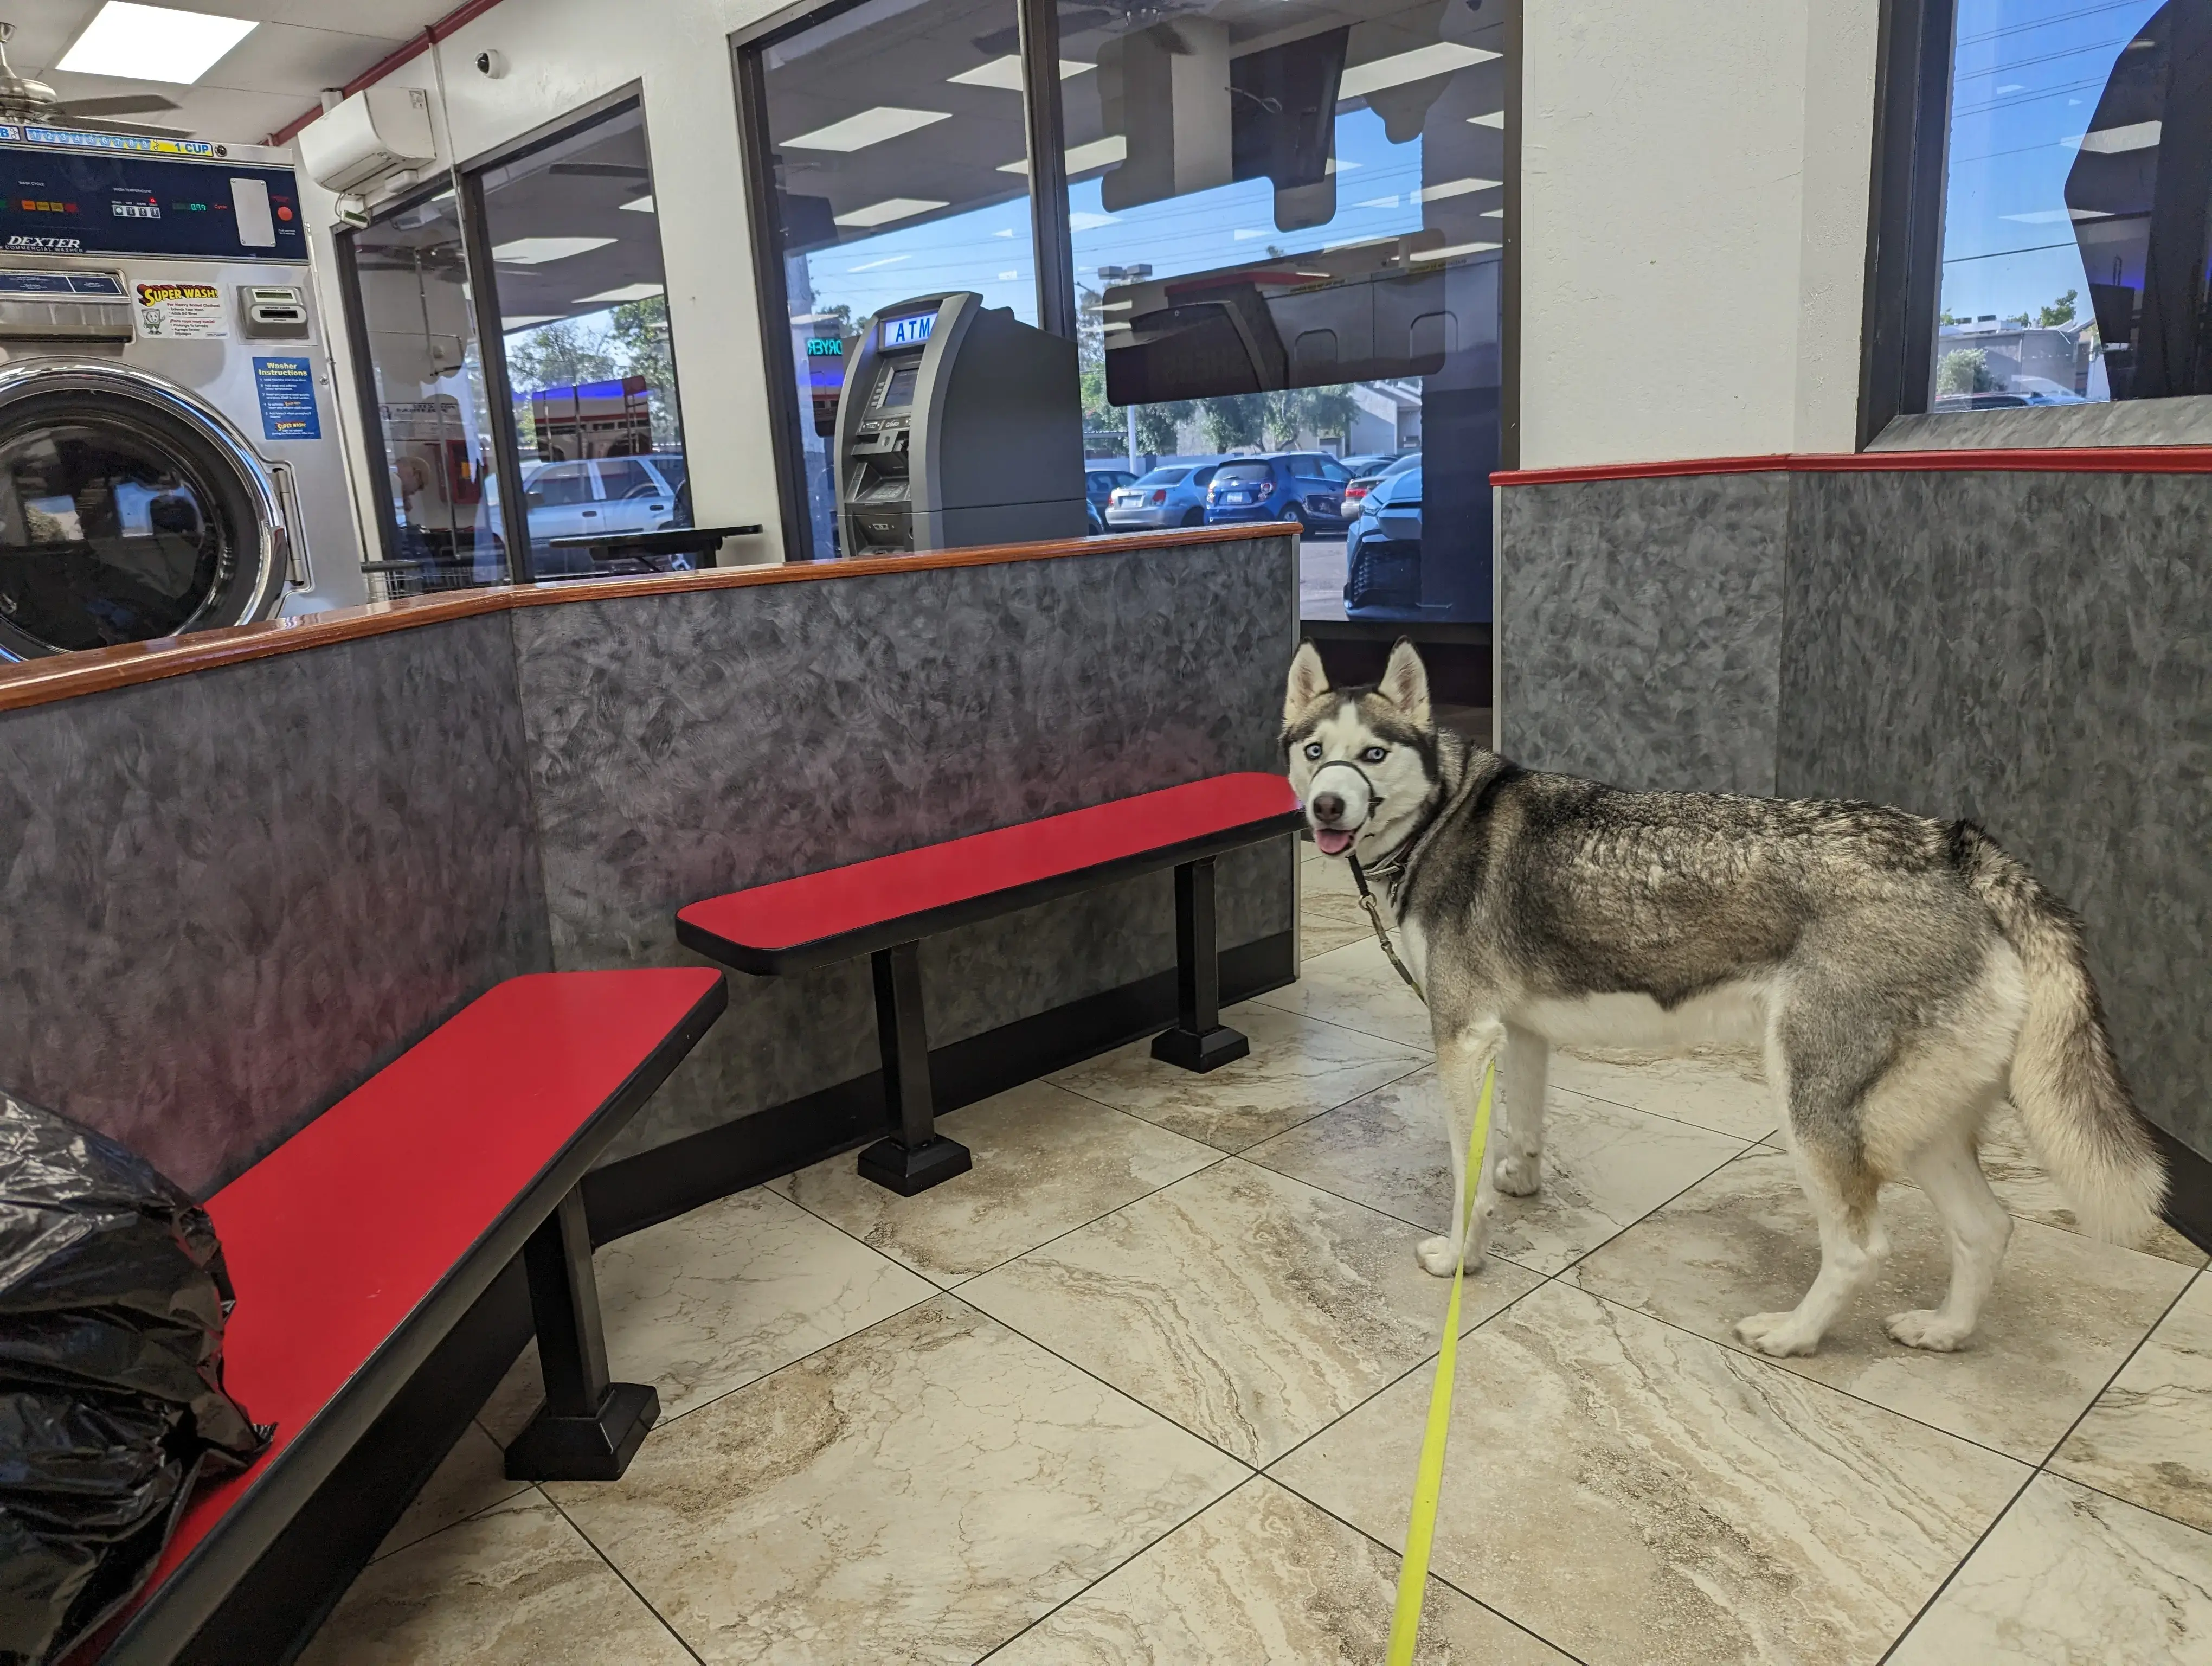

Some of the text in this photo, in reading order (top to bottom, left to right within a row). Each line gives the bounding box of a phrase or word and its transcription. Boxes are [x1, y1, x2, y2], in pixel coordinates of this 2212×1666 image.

[175, 143, 209, 154] 1 CUP
[7, 236, 80, 248] DEXTER
[142, 287, 219, 307] SUPER WASH!
[895, 317, 931, 343] ATM
